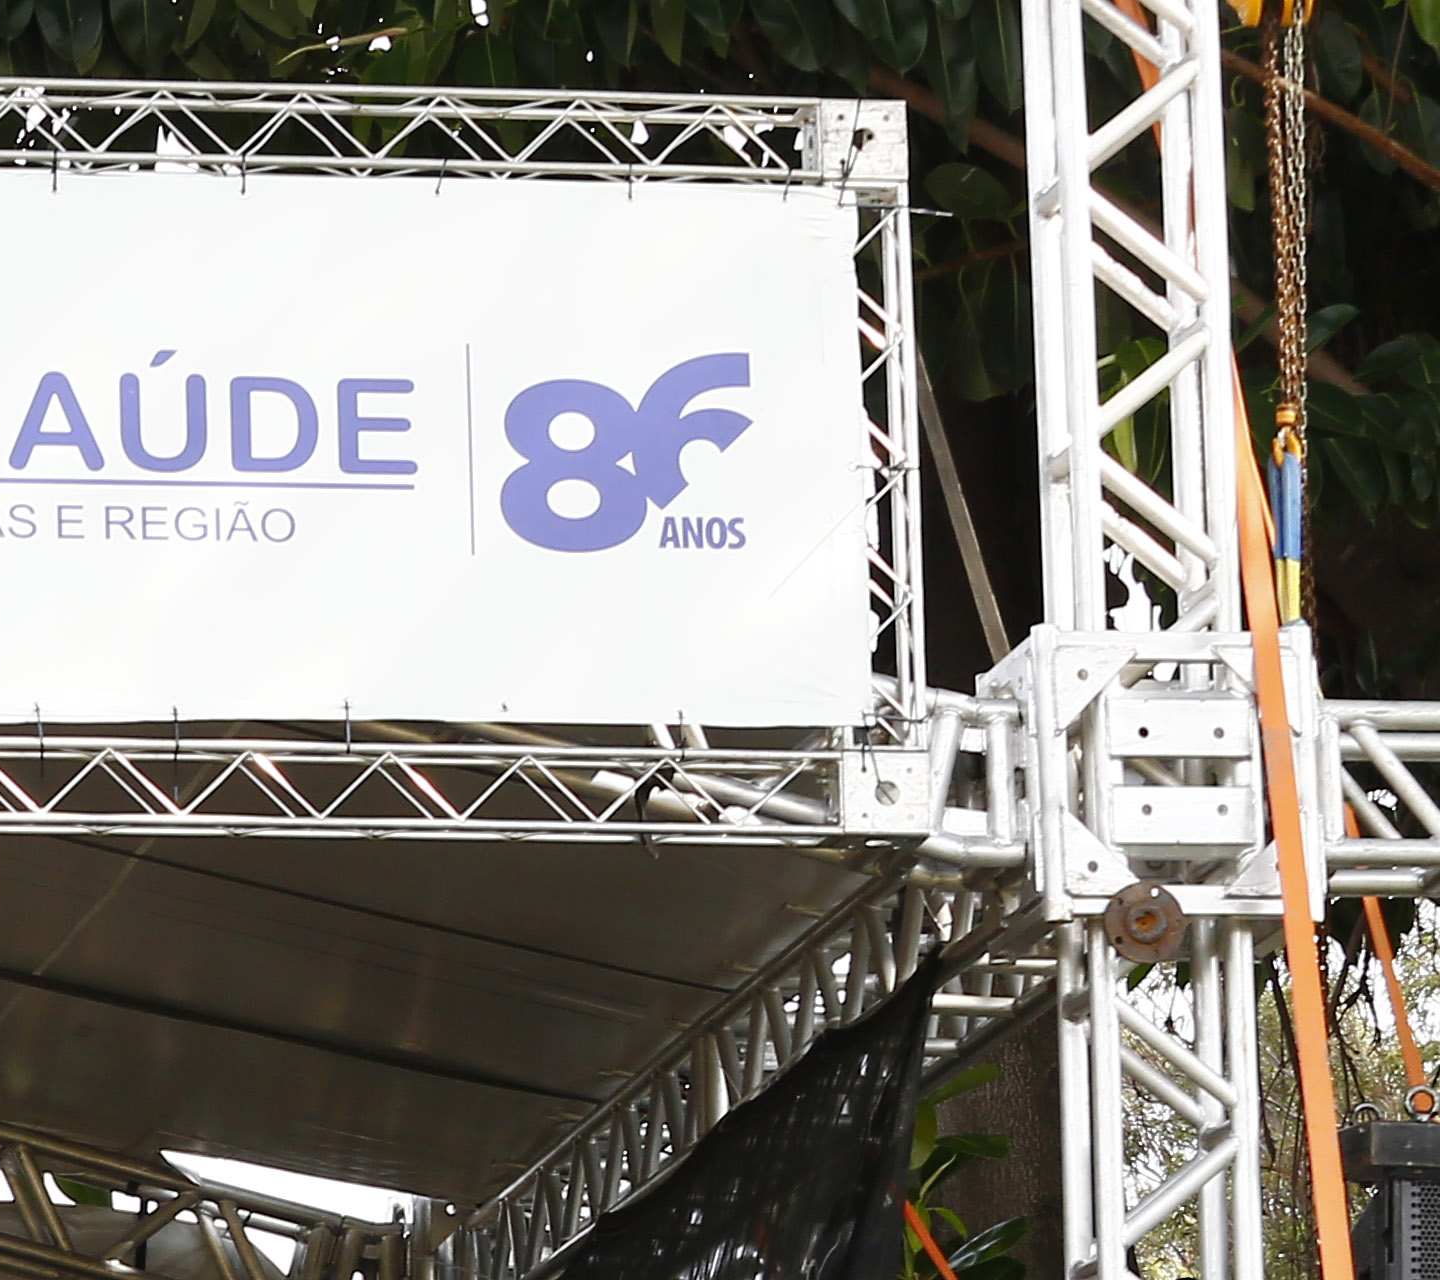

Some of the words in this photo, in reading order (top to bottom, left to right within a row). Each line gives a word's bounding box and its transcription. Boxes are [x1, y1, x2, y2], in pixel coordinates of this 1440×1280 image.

[56, 504, 86, 540] E
[103, 499, 297, 543] REGIÃO
[658, 516, 747, 550] ANOS
